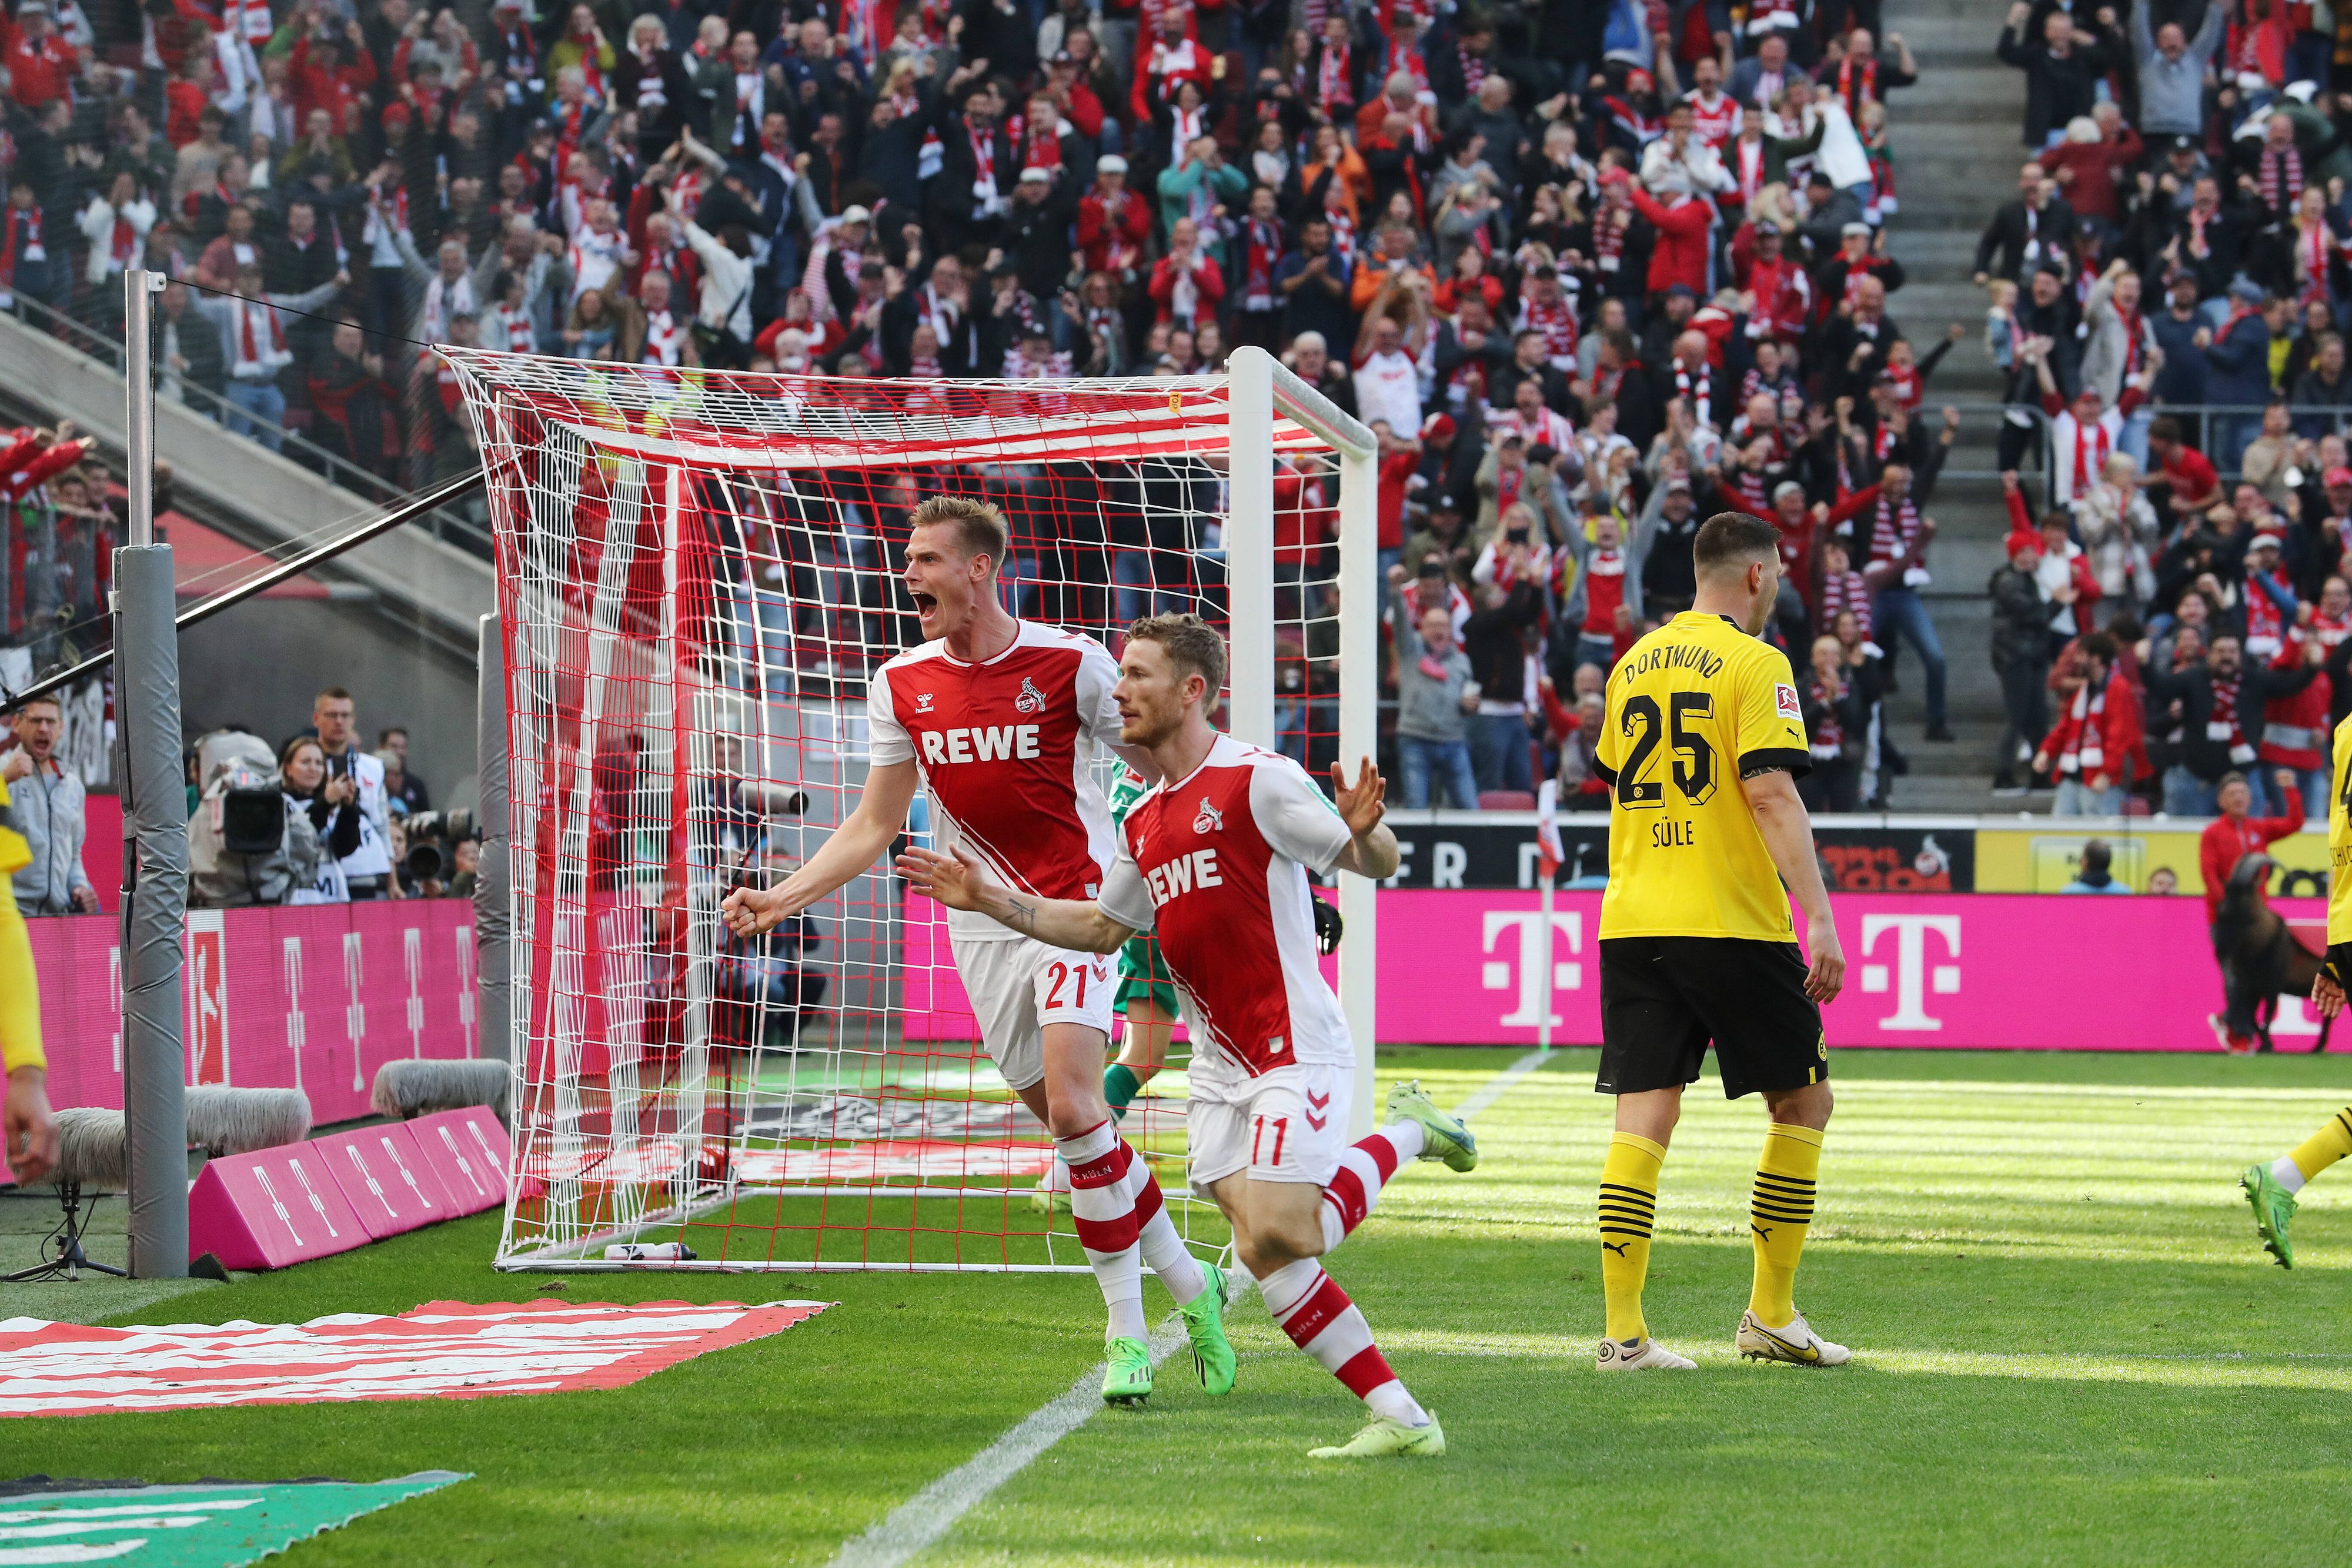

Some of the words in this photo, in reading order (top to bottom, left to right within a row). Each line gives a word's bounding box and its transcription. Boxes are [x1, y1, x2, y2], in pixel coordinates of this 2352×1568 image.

[1625, 644, 1723, 684] DORTMUND
[921, 724, 1040, 765] REWE
[1618, 691, 1717, 811] 25
[1652, 815, 1695, 848] SÜLE
[1045, 961, 1087, 1010] 21
[1252, 1114, 1288, 1166] 11
[1081, 1165, 1112, 1180] KÖLN
